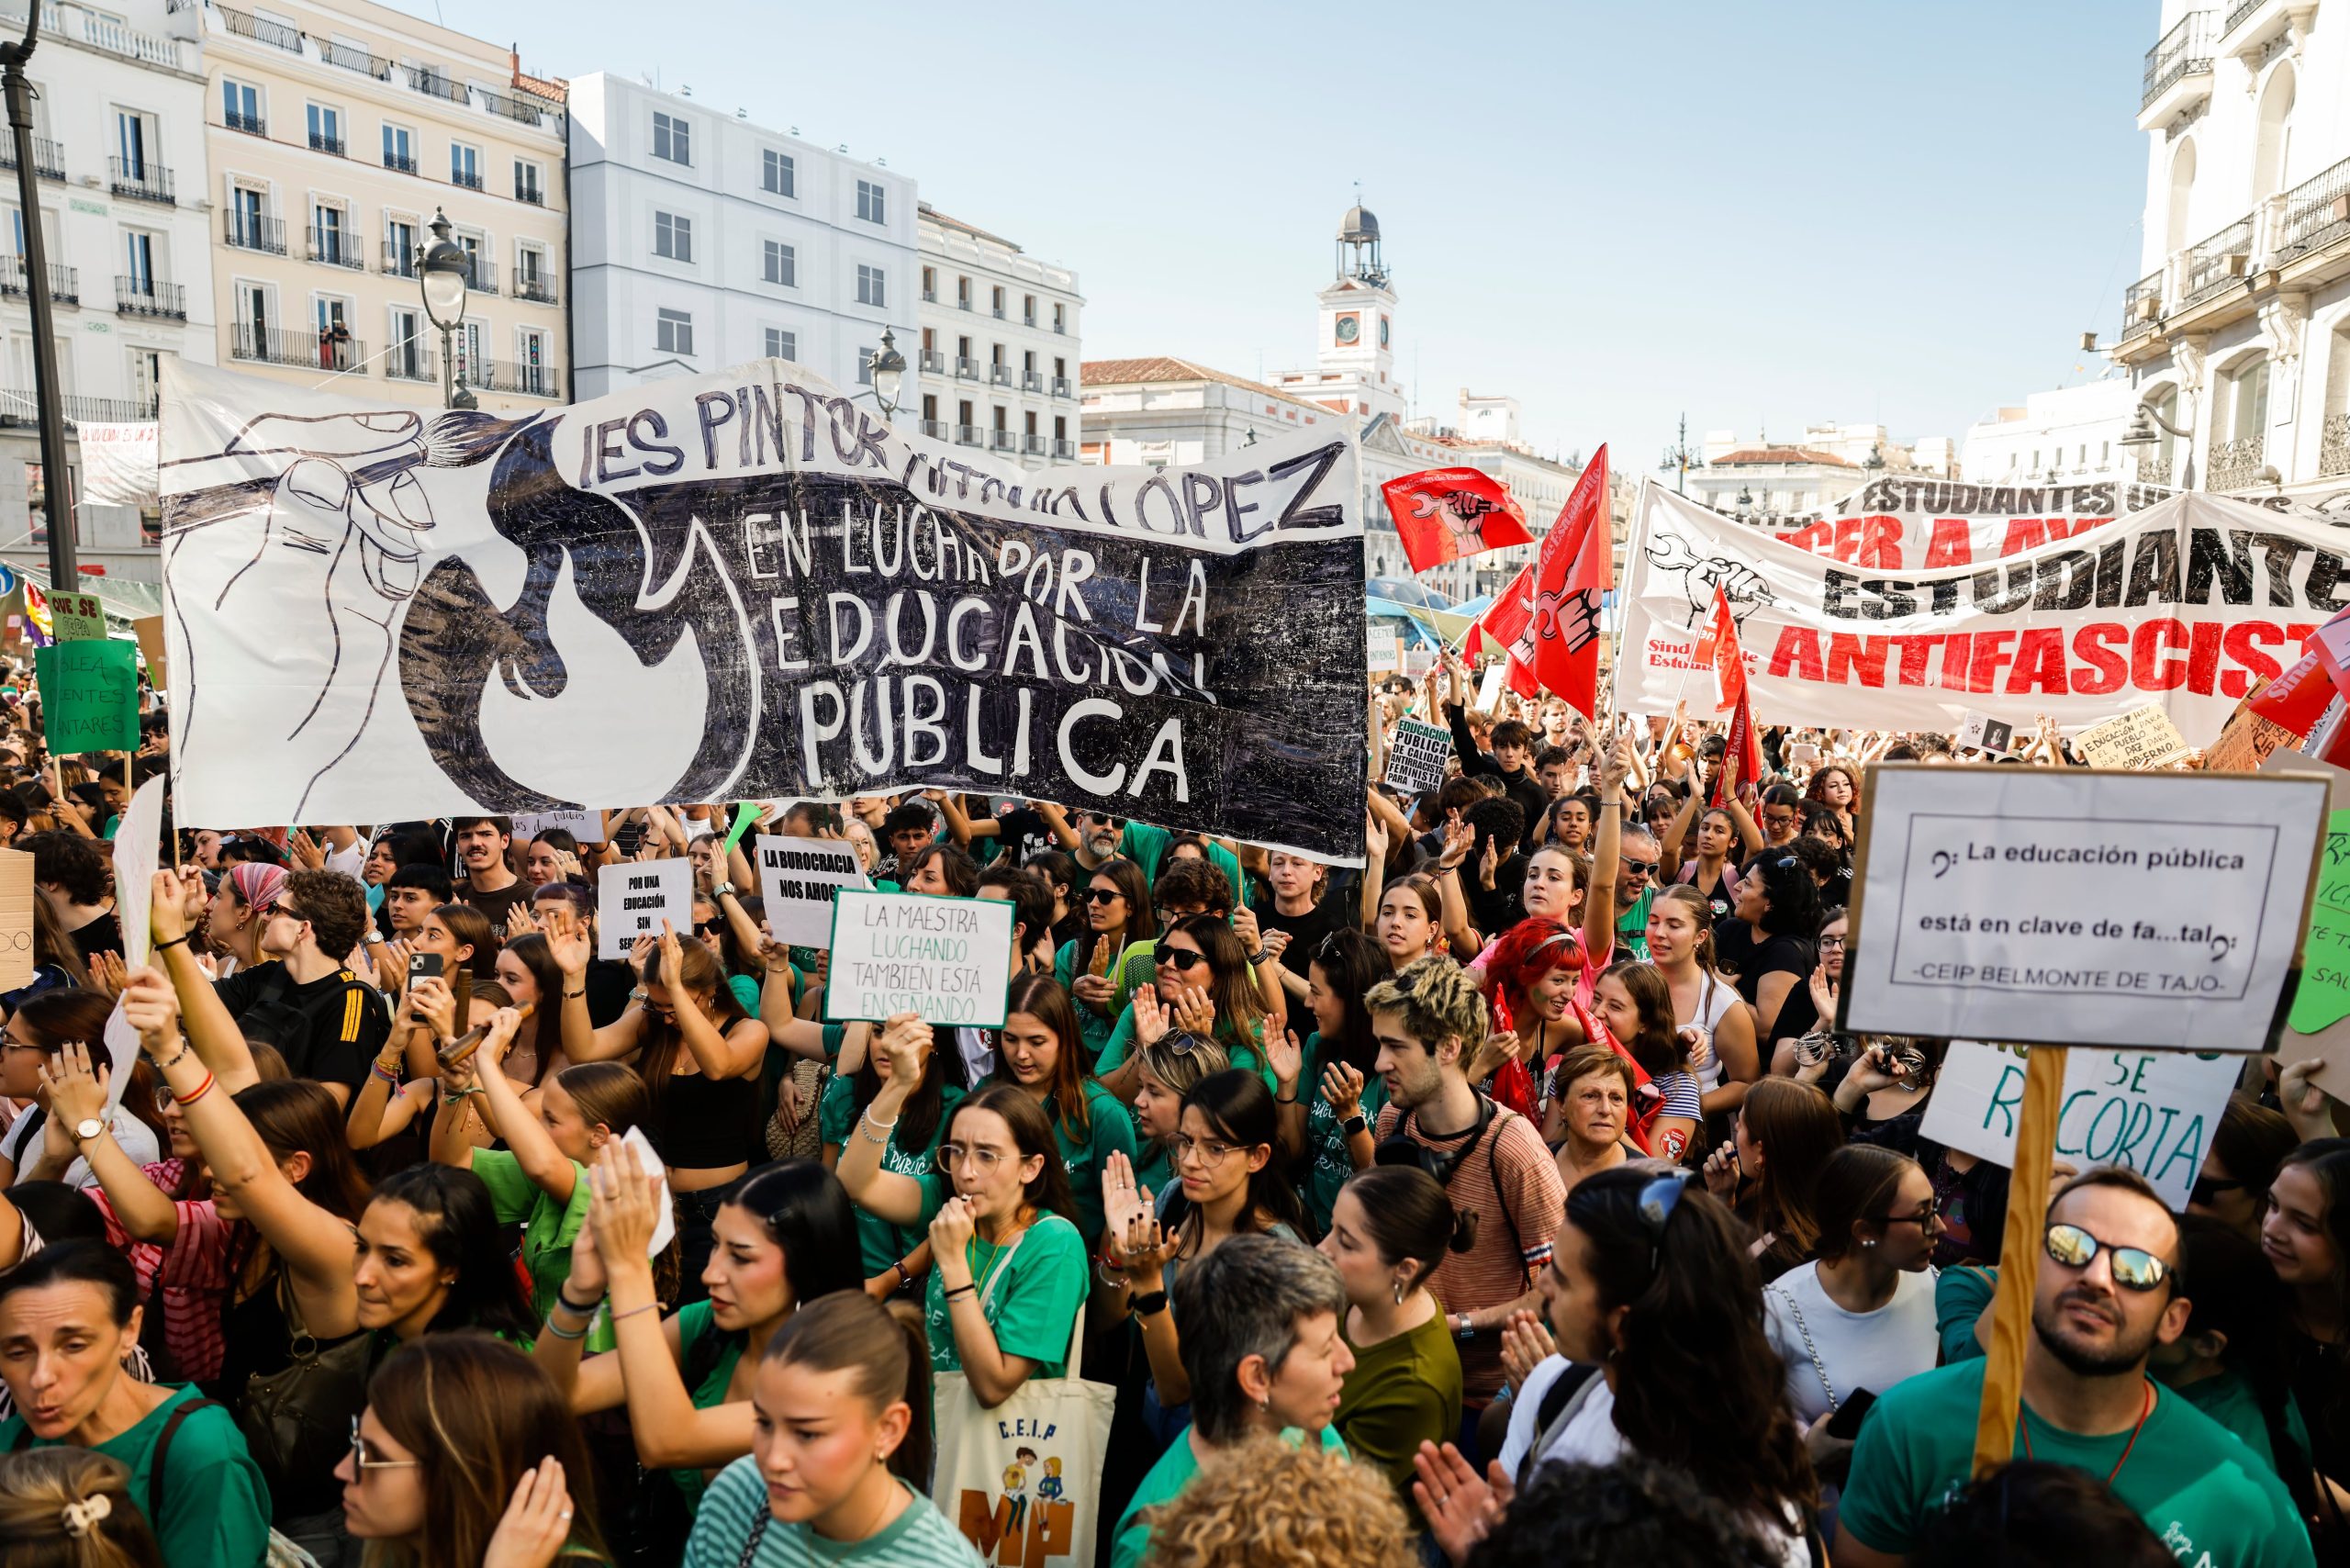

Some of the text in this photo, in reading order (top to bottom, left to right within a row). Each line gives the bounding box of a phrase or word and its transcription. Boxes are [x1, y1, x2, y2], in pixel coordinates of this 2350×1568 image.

[579, 409, 685, 488] IES
[695, 382, 890, 470] PINTOR
[1550, 465, 1603, 545] Estudiante
[1862, 475, 2116, 516] ESTUDIANTES
[1923, 518, 1973, 569] A
[744, 509, 812, 580] EN
[999, 540, 1096, 622] POR
[1134, 556, 1208, 637] LA
[52, 597, 97, 619] QUE SE
[800, 657, 1191, 804] PÚBLICA
[1398, 720, 1451, 744] EDUCACIÓN
[2114, 730, 2147, 749] PUEBLO
[1393, 744, 1446, 767] DE CALIDAD
[2124, 742, 2143, 756] PAZ
[2146, 733, 2170, 747] PARA
[1389, 763, 1439, 785] FEMINISTA
[1390, 754, 1444, 776] ANTIRRACISTA
[1387, 773, 1408, 785] PARA
[1412, 778, 1438, 793] TODAS
[764, 849, 856, 874] LA BUROCRACIA
[1967, 842, 2245, 872] La educación pública
[629, 875, 660, 890] POR UNA
[779, 879, 804, 900] NOS
[623, 893, 666, 911] EDUCACIÓN
[637, 916, 651, 930] SIN
[865, 903, 979, 934] LA MAESTRA
[1919, 913, 2212, 944] está en clave de fa...tal
[872, 933, 968, 963] LUCHANDO
[852, 962, 981, 994] TAMBIÉN ESTÁ
[1980, 964, 2109, 989] BELMONTE
[2115, 970, 2150, 991] DE
[861, 991, 976, 1023] ENSEÑANDO
[2104, 1052, 2156, 1095] SE
[1982, 1064, 2205, 1192] RCORTA
[998, 1418, 1058, 1441] C.E.I.P
